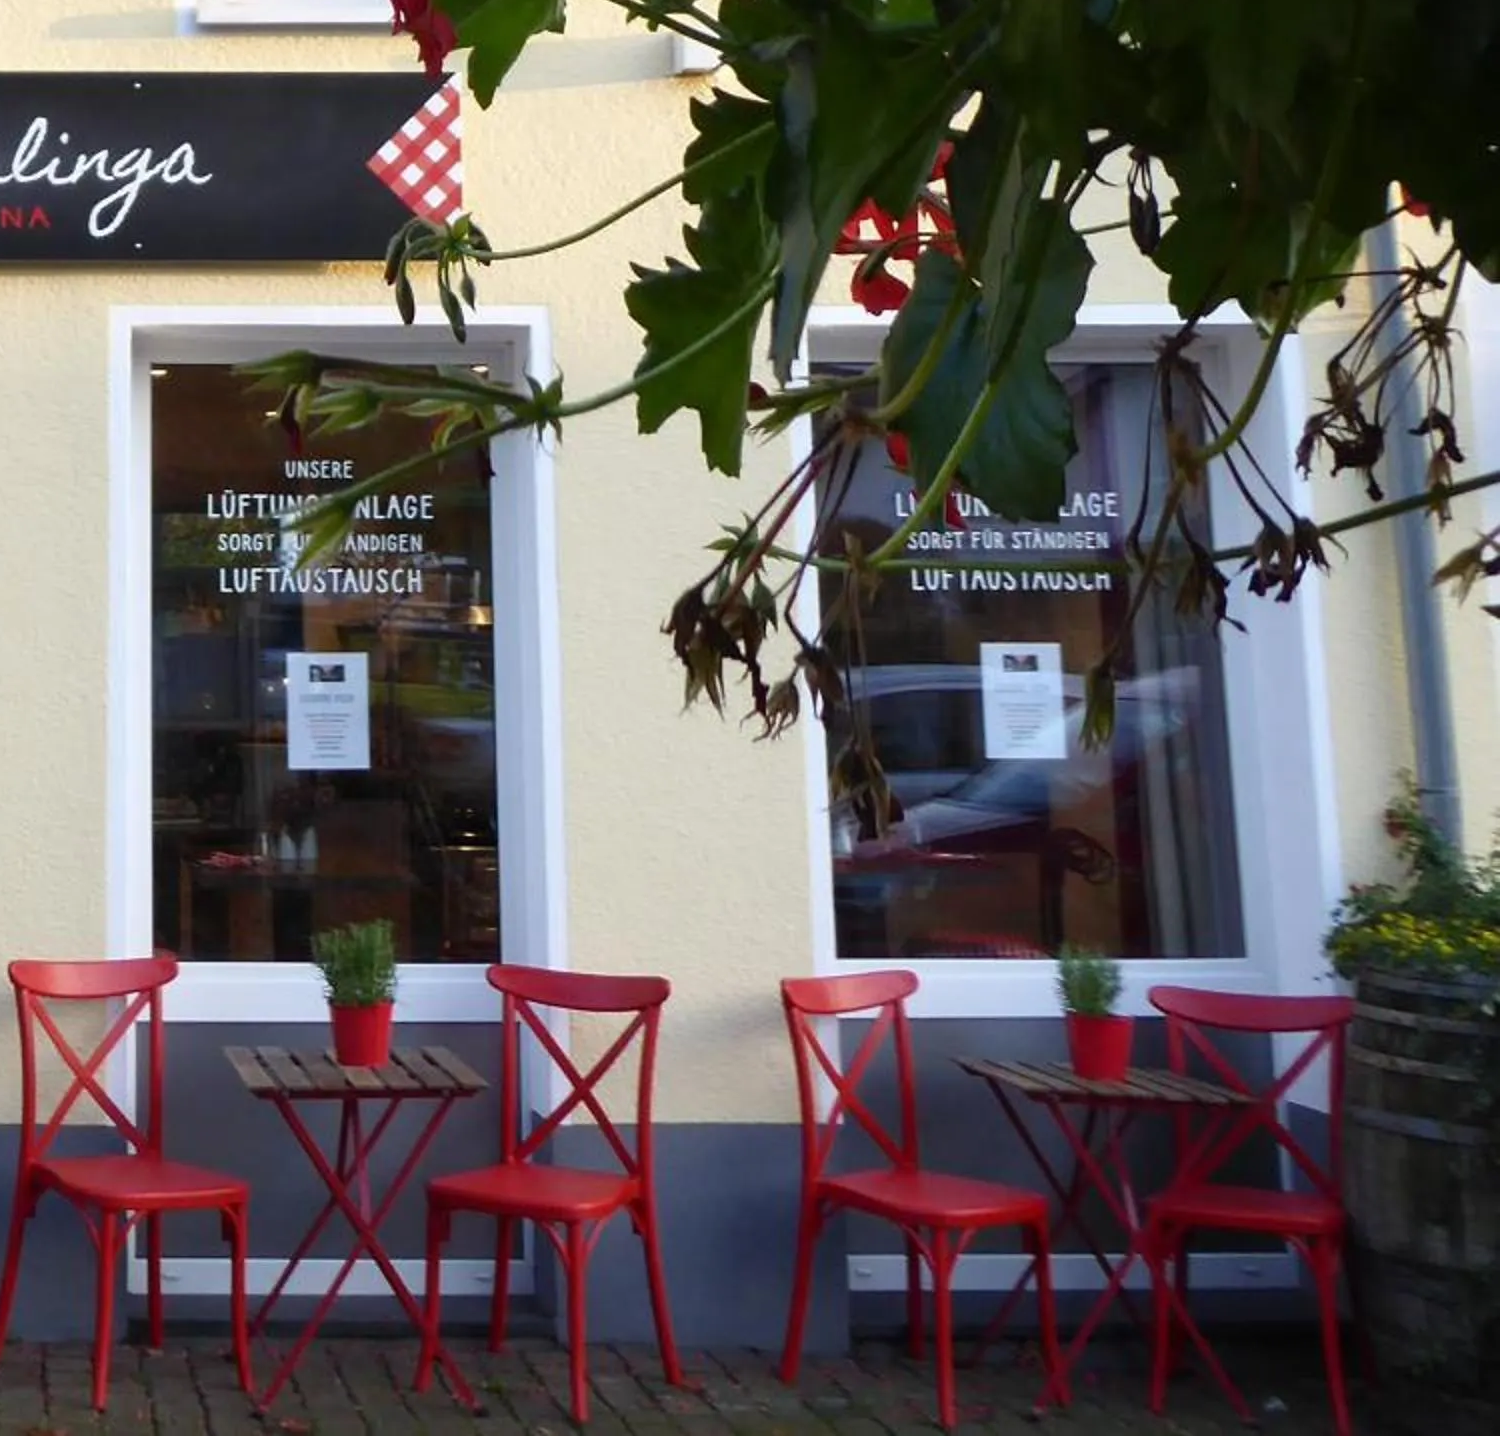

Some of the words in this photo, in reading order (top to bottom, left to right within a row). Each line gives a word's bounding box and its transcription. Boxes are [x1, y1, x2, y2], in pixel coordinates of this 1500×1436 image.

[285, 460, 354, 479] UNSERE
[217, 533, 275, 553] SORGT
[330, 531, 424, 553] ÄNDIGEN
[907, 531, 964, 550] SORGT
[971, 529, 1005, 550] FÜR
[1012, 529, 1110, 550] STÄNDIGEN
[219, 568, 424, 594] LUFTAUSTAUSCH
